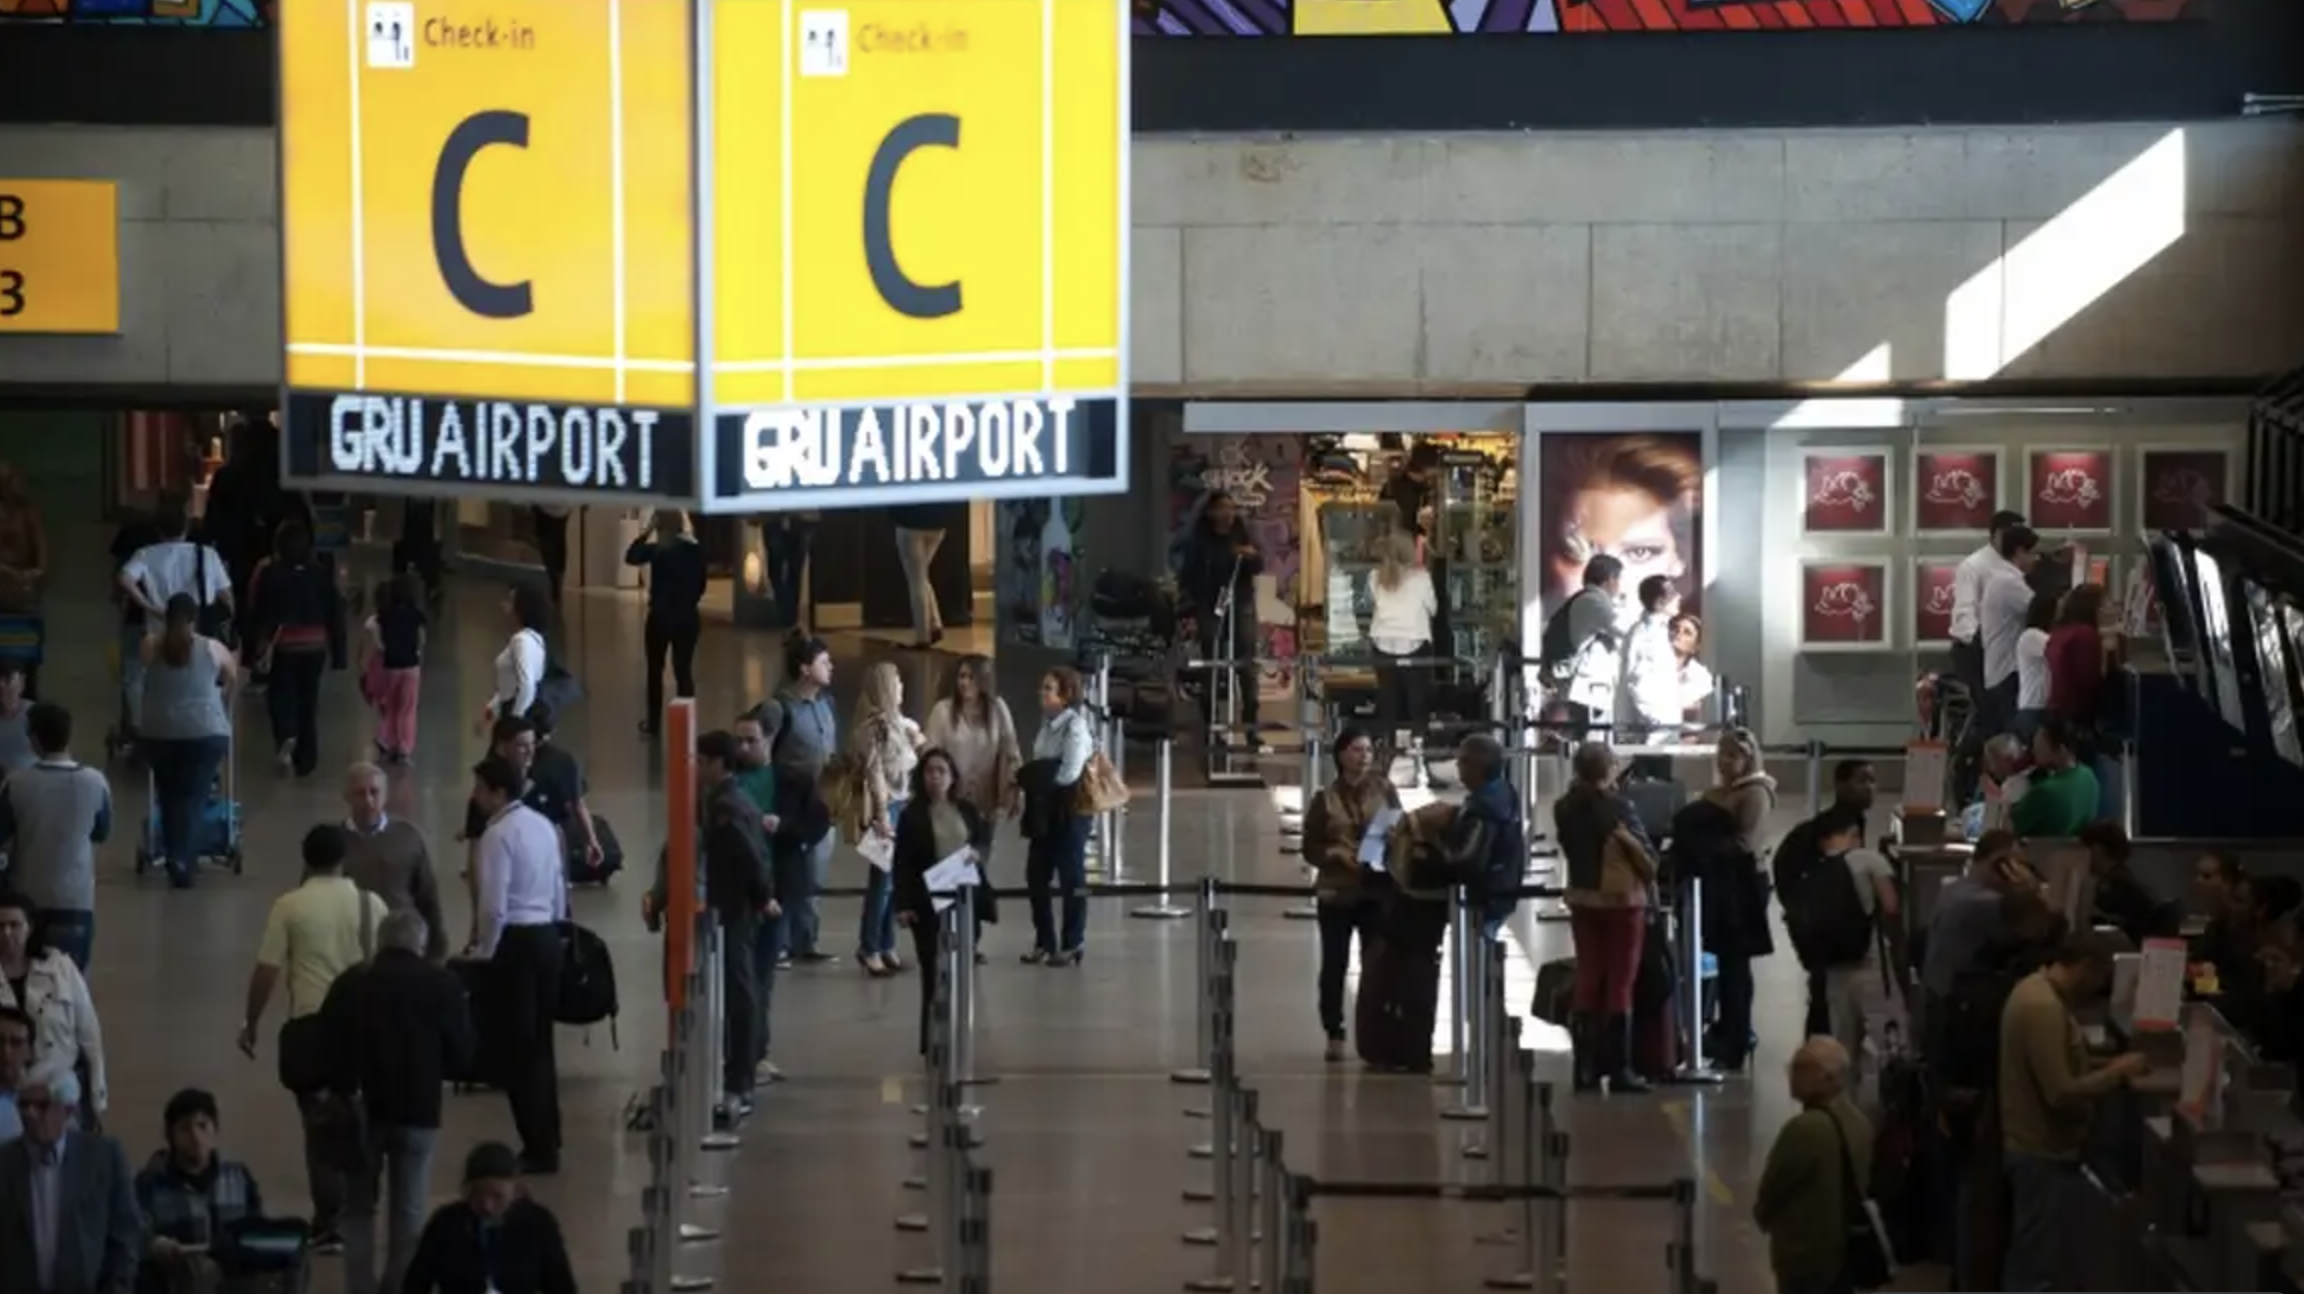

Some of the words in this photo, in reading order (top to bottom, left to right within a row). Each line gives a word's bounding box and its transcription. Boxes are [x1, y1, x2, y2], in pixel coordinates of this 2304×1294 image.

[424, 17, 536, 49] Check-in
[856, 23, 970, 54] Check-in
[431, 109, 534, 319] C
[863, 112, 963, 319] C
[331, 394, 423, 474] GRU
[430, 399, 659, 488] AIRPORT
[743, 404, 842, 489] GRU
[848, 396, 1075, 484] AIRPORT
